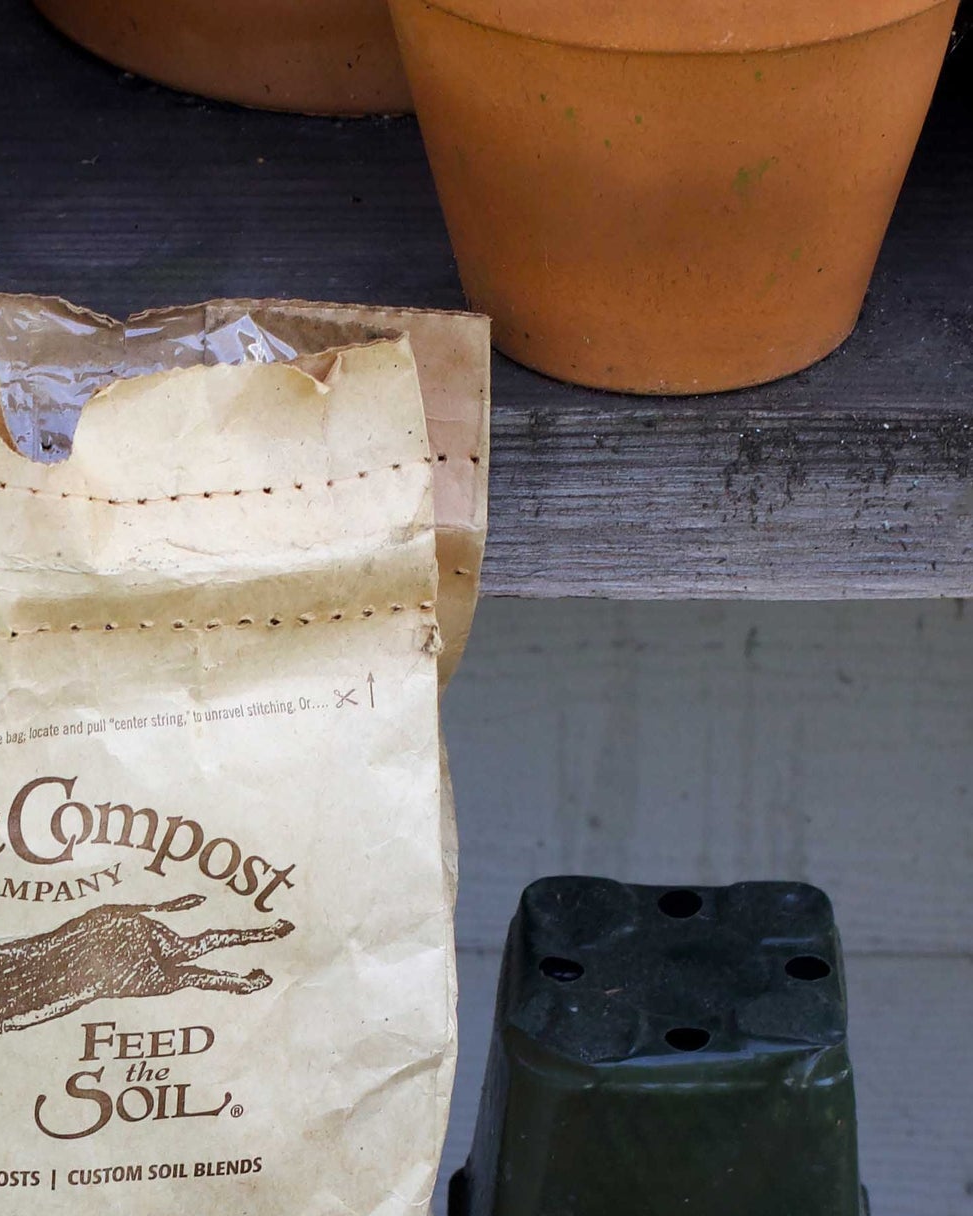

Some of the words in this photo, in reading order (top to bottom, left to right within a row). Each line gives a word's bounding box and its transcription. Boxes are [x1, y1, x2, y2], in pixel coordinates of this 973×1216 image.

[29, 724, 59, 740] locate
[63, 721, 83, 736] and
[87, 714, 106, 735] pull
[193, 711, 202, 722] to
[205, 706, 244, 722] unravel
[247, 700, 296, 717] stitching.
[7, 775, 296, 913] Compost
[80, 1021, 215, 1061] FEED
[126, 1060, 170, 1081] the
[68, 1163, 143, 1186] CUSTOM
[148, 1163, 188, 1181] SOIL
[193, 1156, 263, 1177] BLENDS
